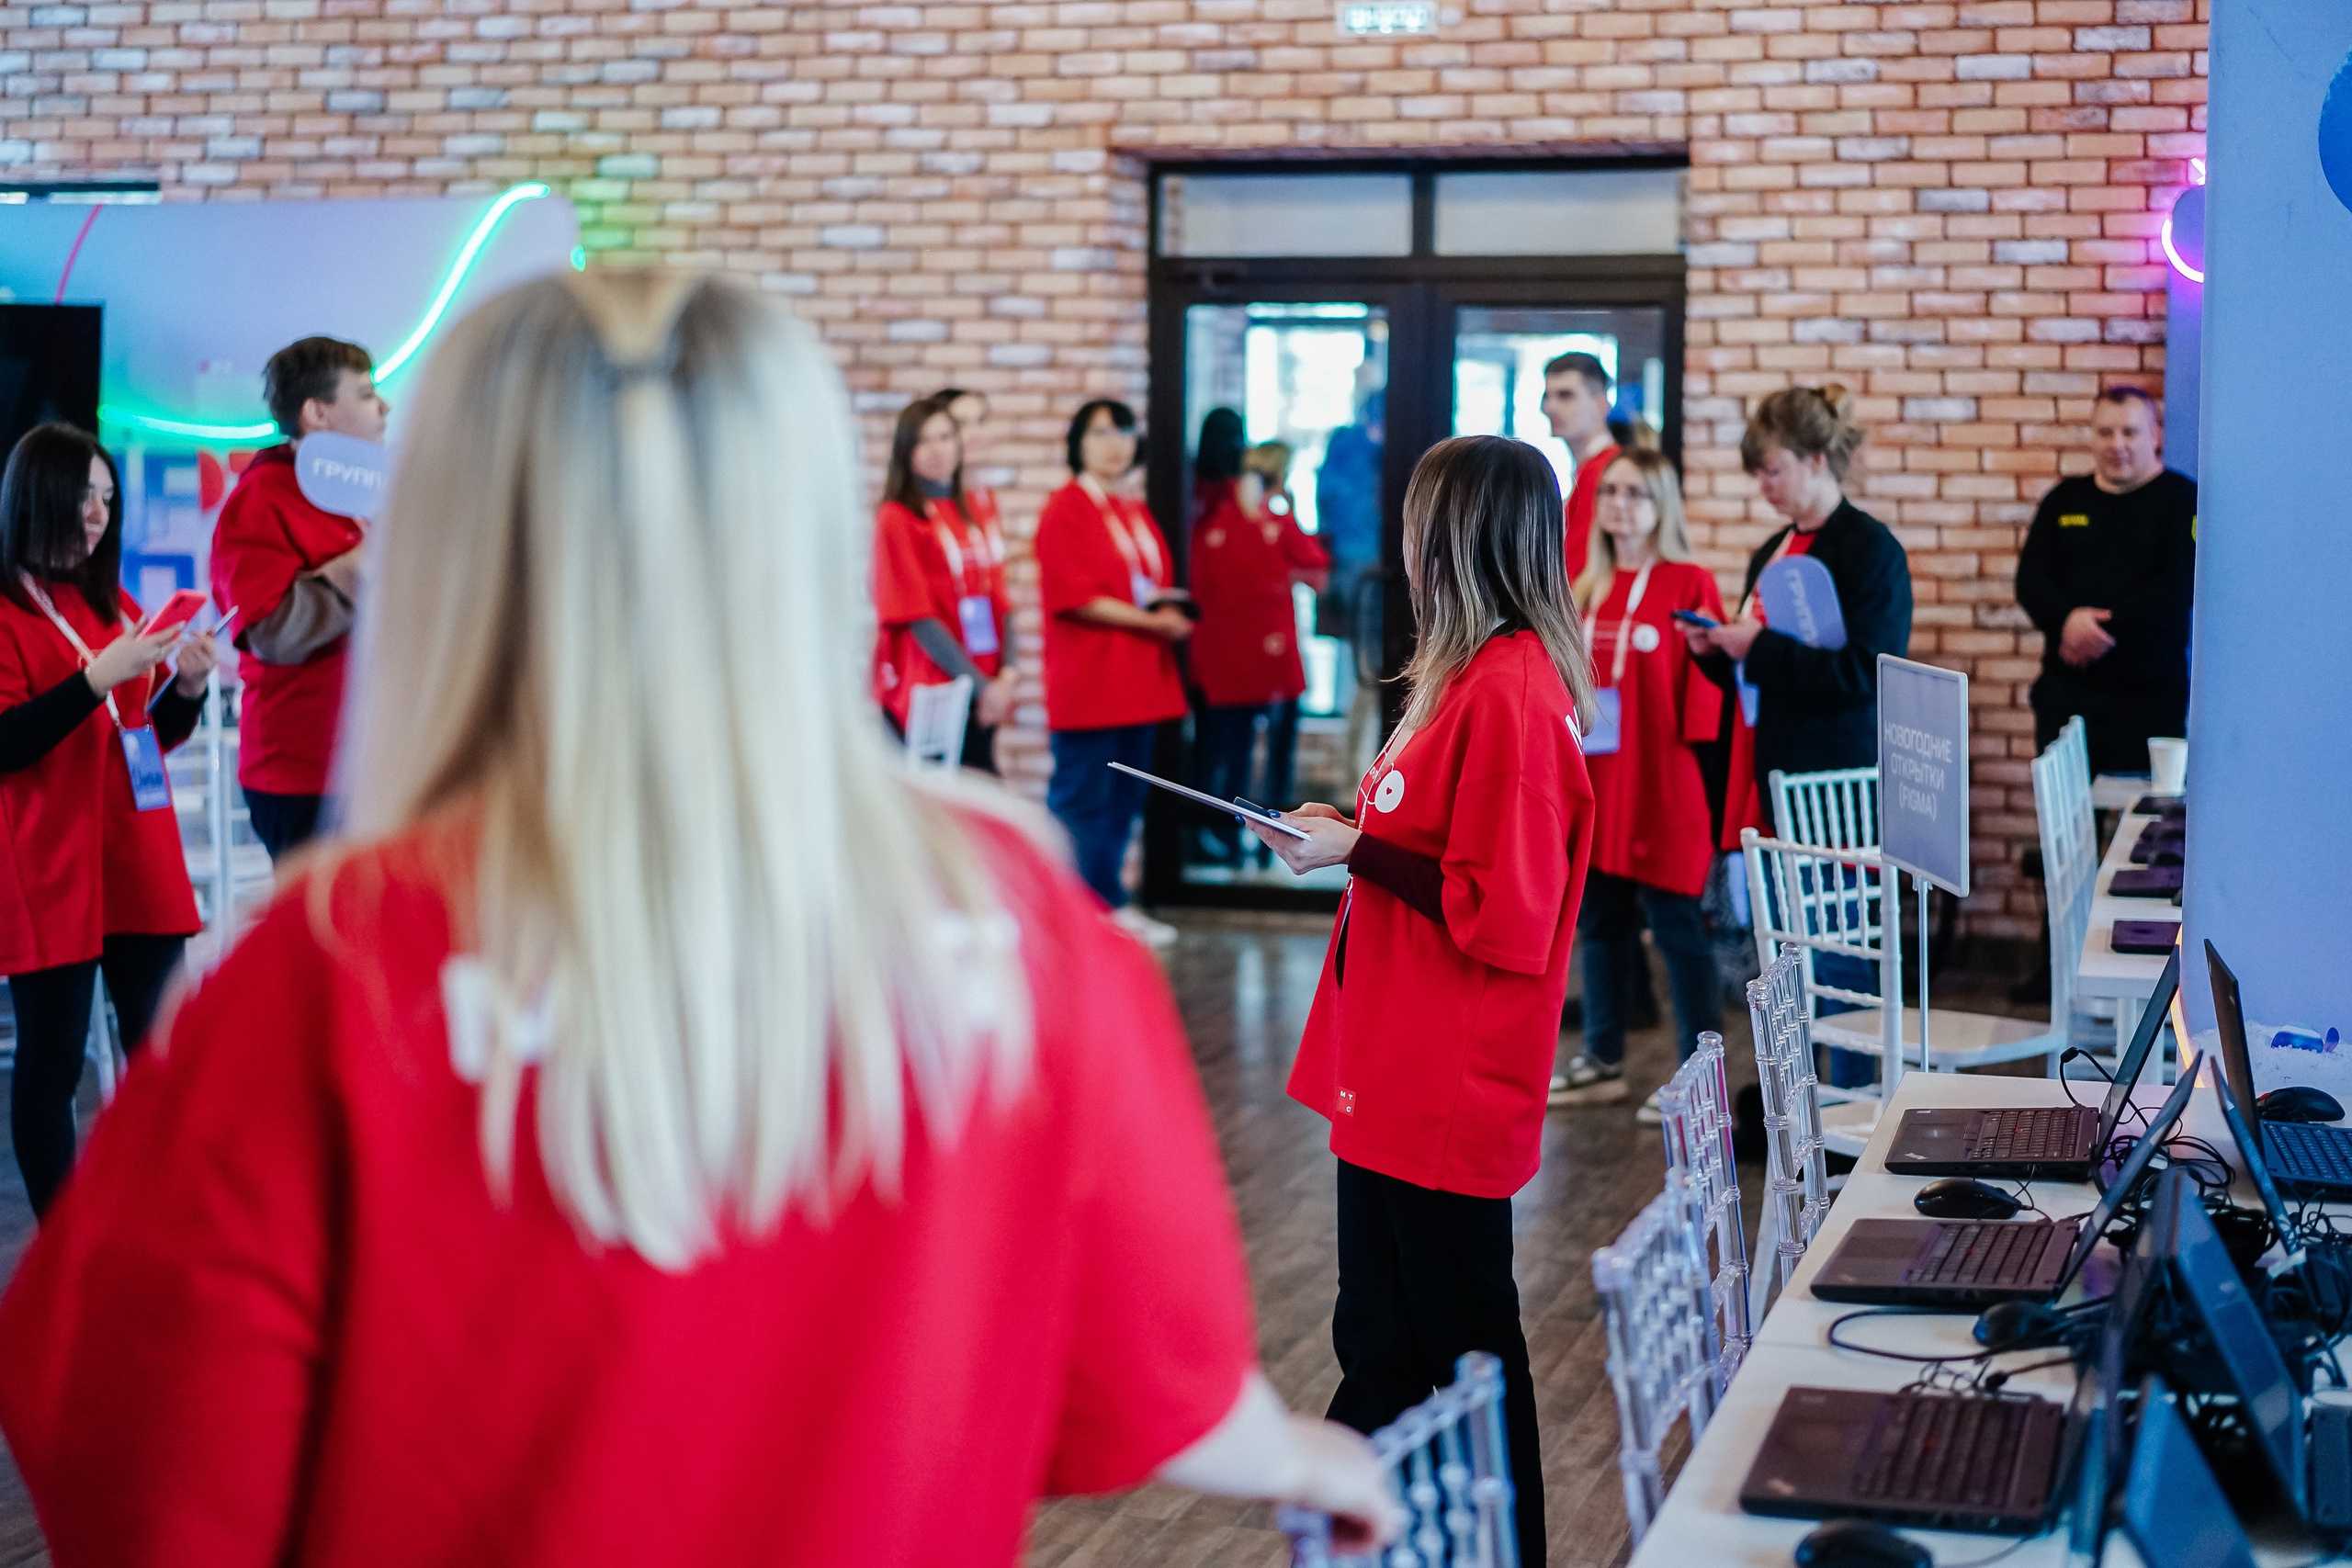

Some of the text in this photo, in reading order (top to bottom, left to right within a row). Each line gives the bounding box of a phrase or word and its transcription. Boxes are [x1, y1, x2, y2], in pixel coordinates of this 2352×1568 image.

[1884, 721, 1952, 763] НОВОГОДНИЕ
[1890, 752, 1945, 791] ОТКРЫТКИ
[1899, 781, 1937, 821] (FIGMA)
